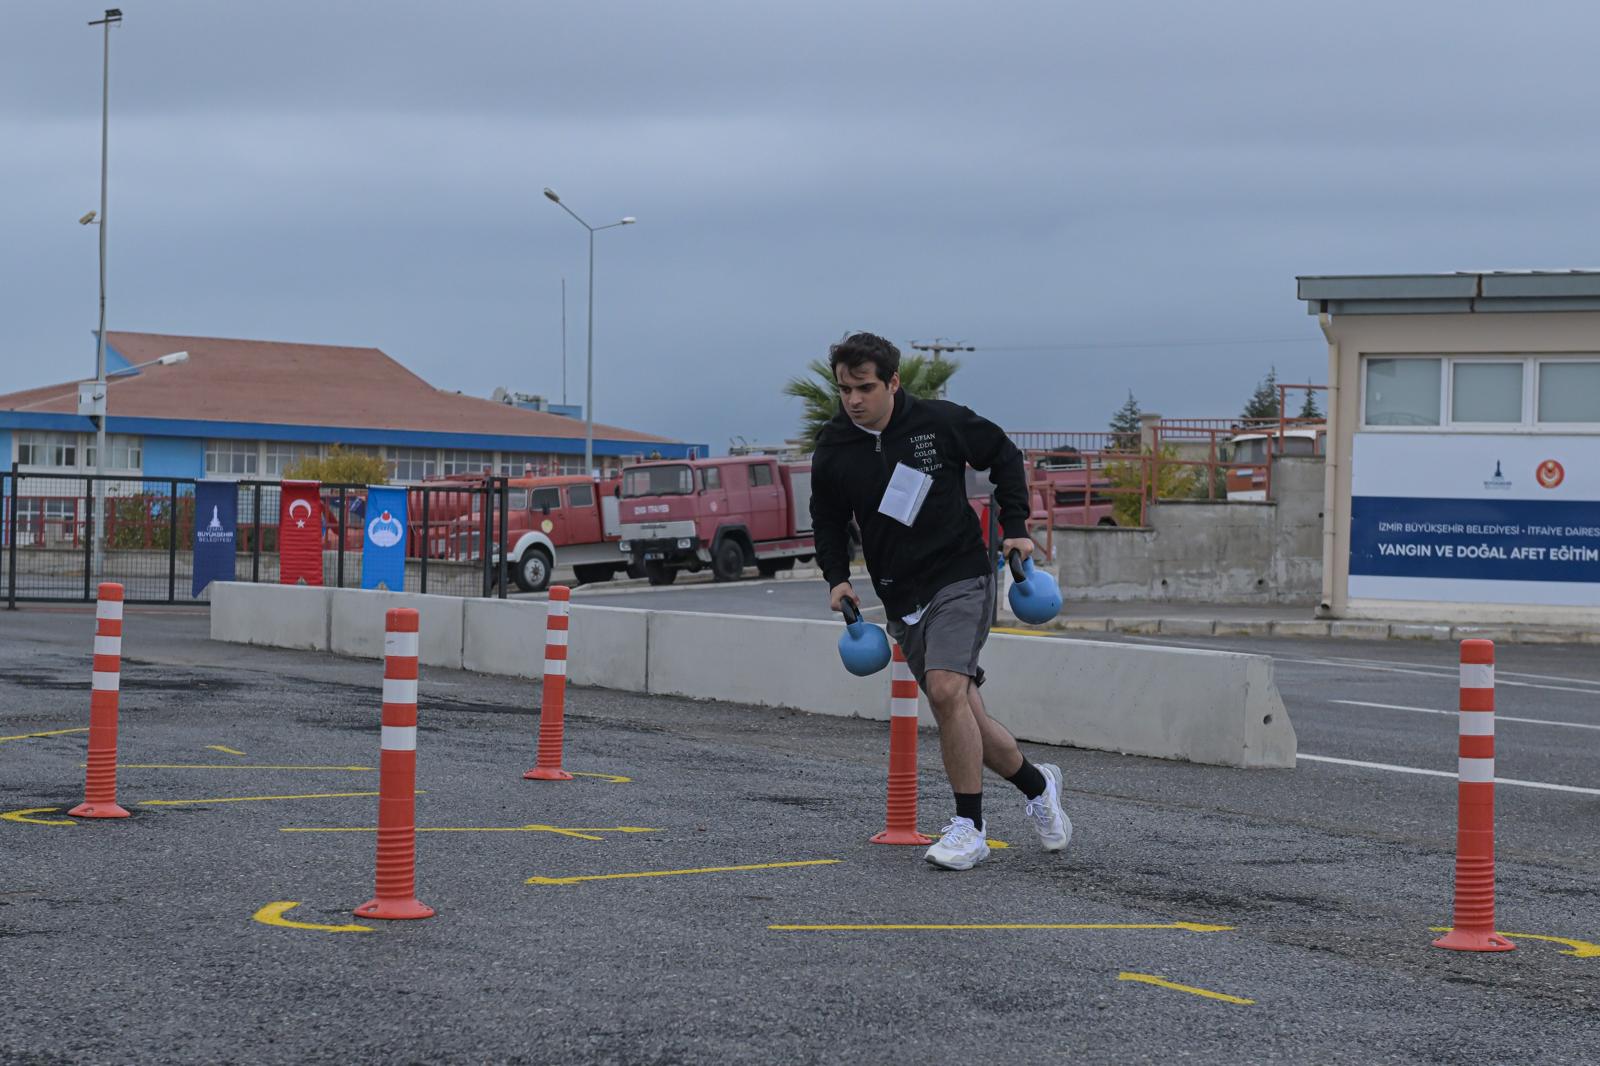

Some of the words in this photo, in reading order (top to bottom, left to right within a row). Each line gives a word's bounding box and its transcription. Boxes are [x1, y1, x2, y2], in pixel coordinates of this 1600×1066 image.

[915, 442, 933, 450] ADDS
[914, 449, 936, 457] COLOR
[1378, 521, 1403, 532] İZMİR
[1405, 522, 1465, 534] BÜYÜKŞEHİR
[1466, 524, 1520, 535] BELEDİYESİ
[1527, 524, 1563, 536] İTFAİYE
[1378, 543, 1431, 557] YANGIN
[1435, 545, 1454, 558] VE
[1457, 543, 1507, 559] DOĞAL
[1511, 547, 1546, 560] AFET
[1549, 545, 1599, 562] EĞİTİM
